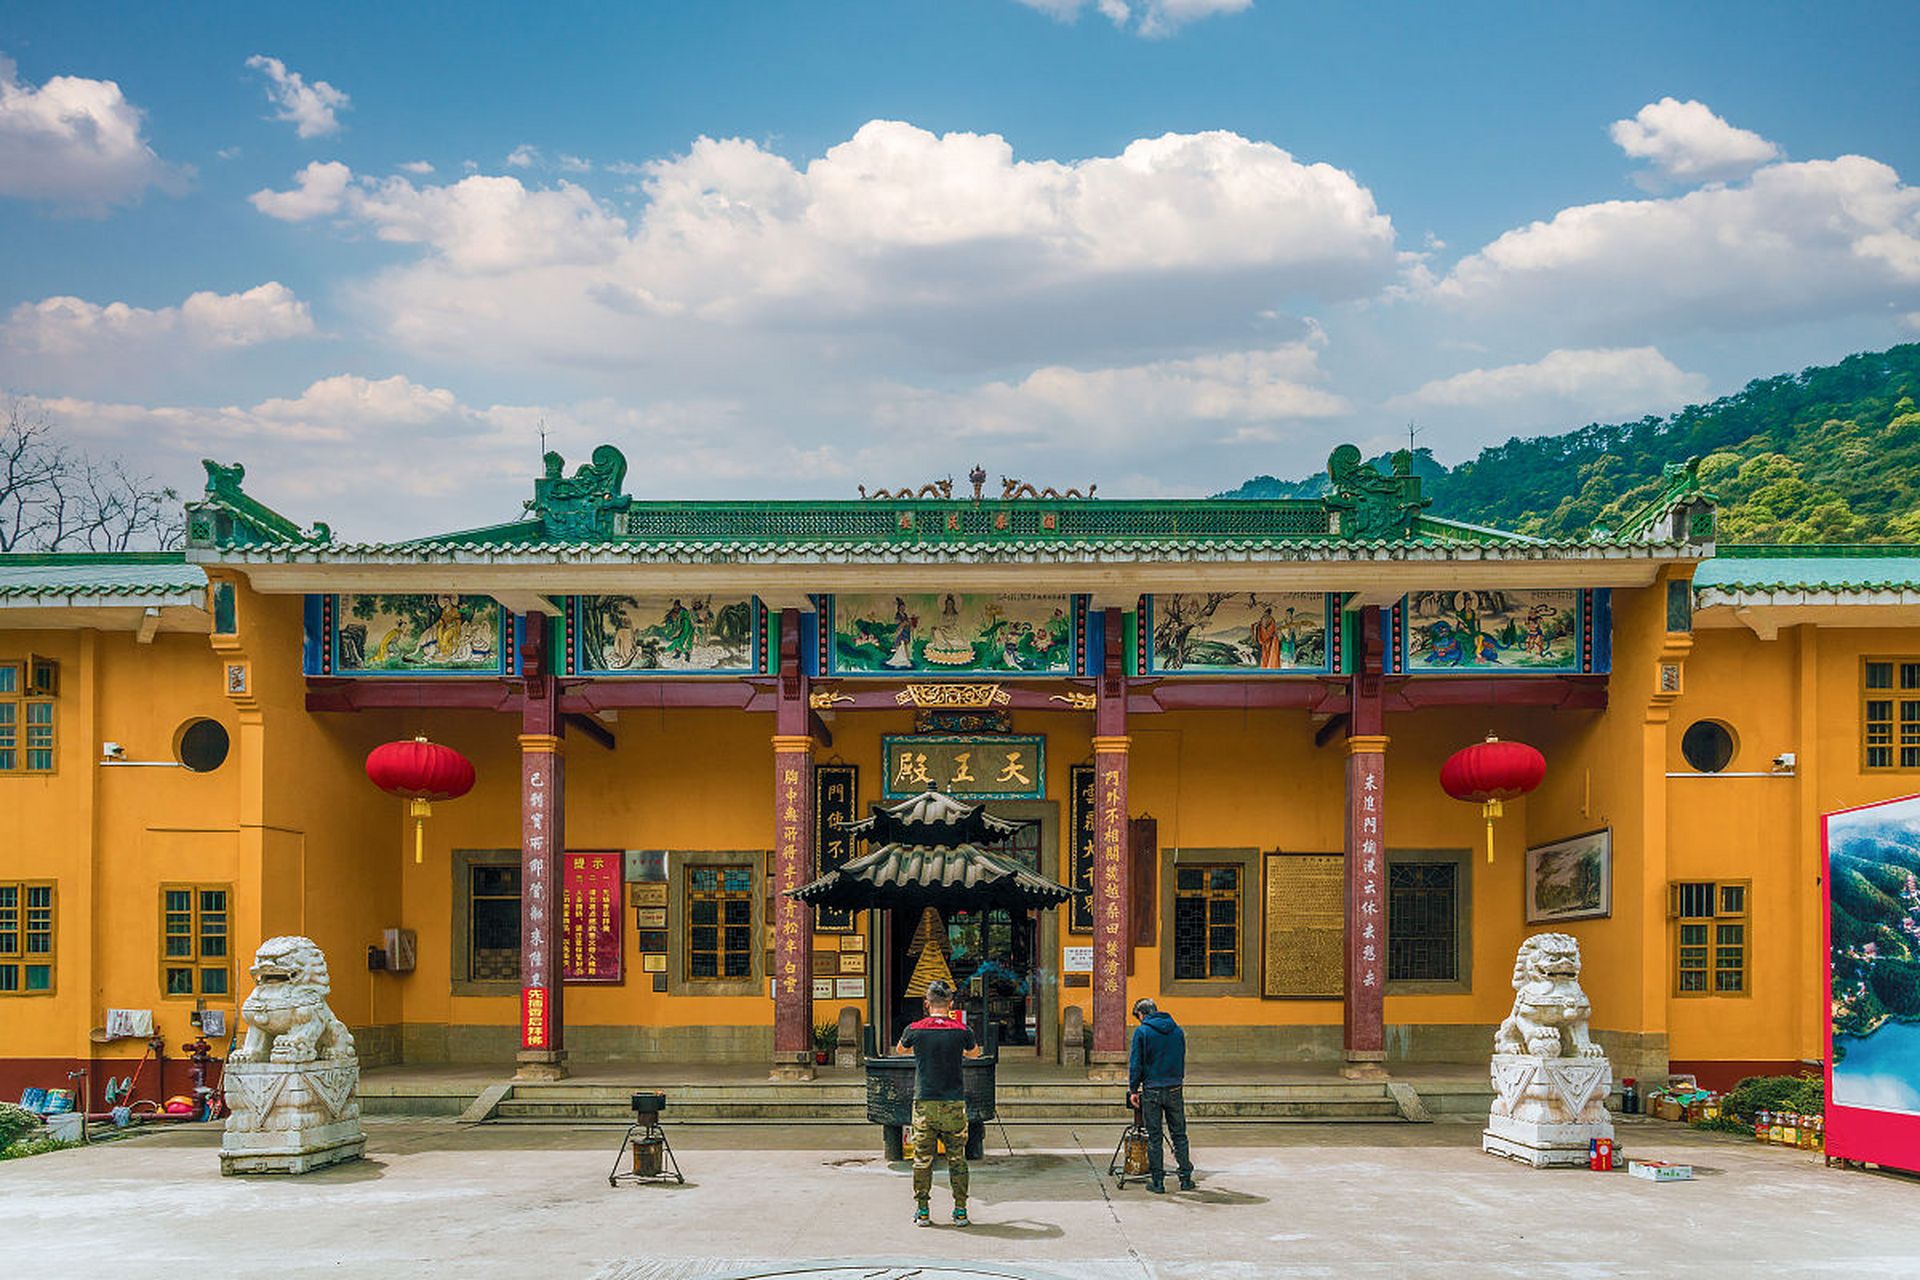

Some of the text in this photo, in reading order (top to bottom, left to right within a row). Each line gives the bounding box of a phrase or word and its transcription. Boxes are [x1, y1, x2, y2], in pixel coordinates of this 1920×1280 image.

[893, 751, 1031, 786] 天王殿
[573, 856, 605, 870] 提示
